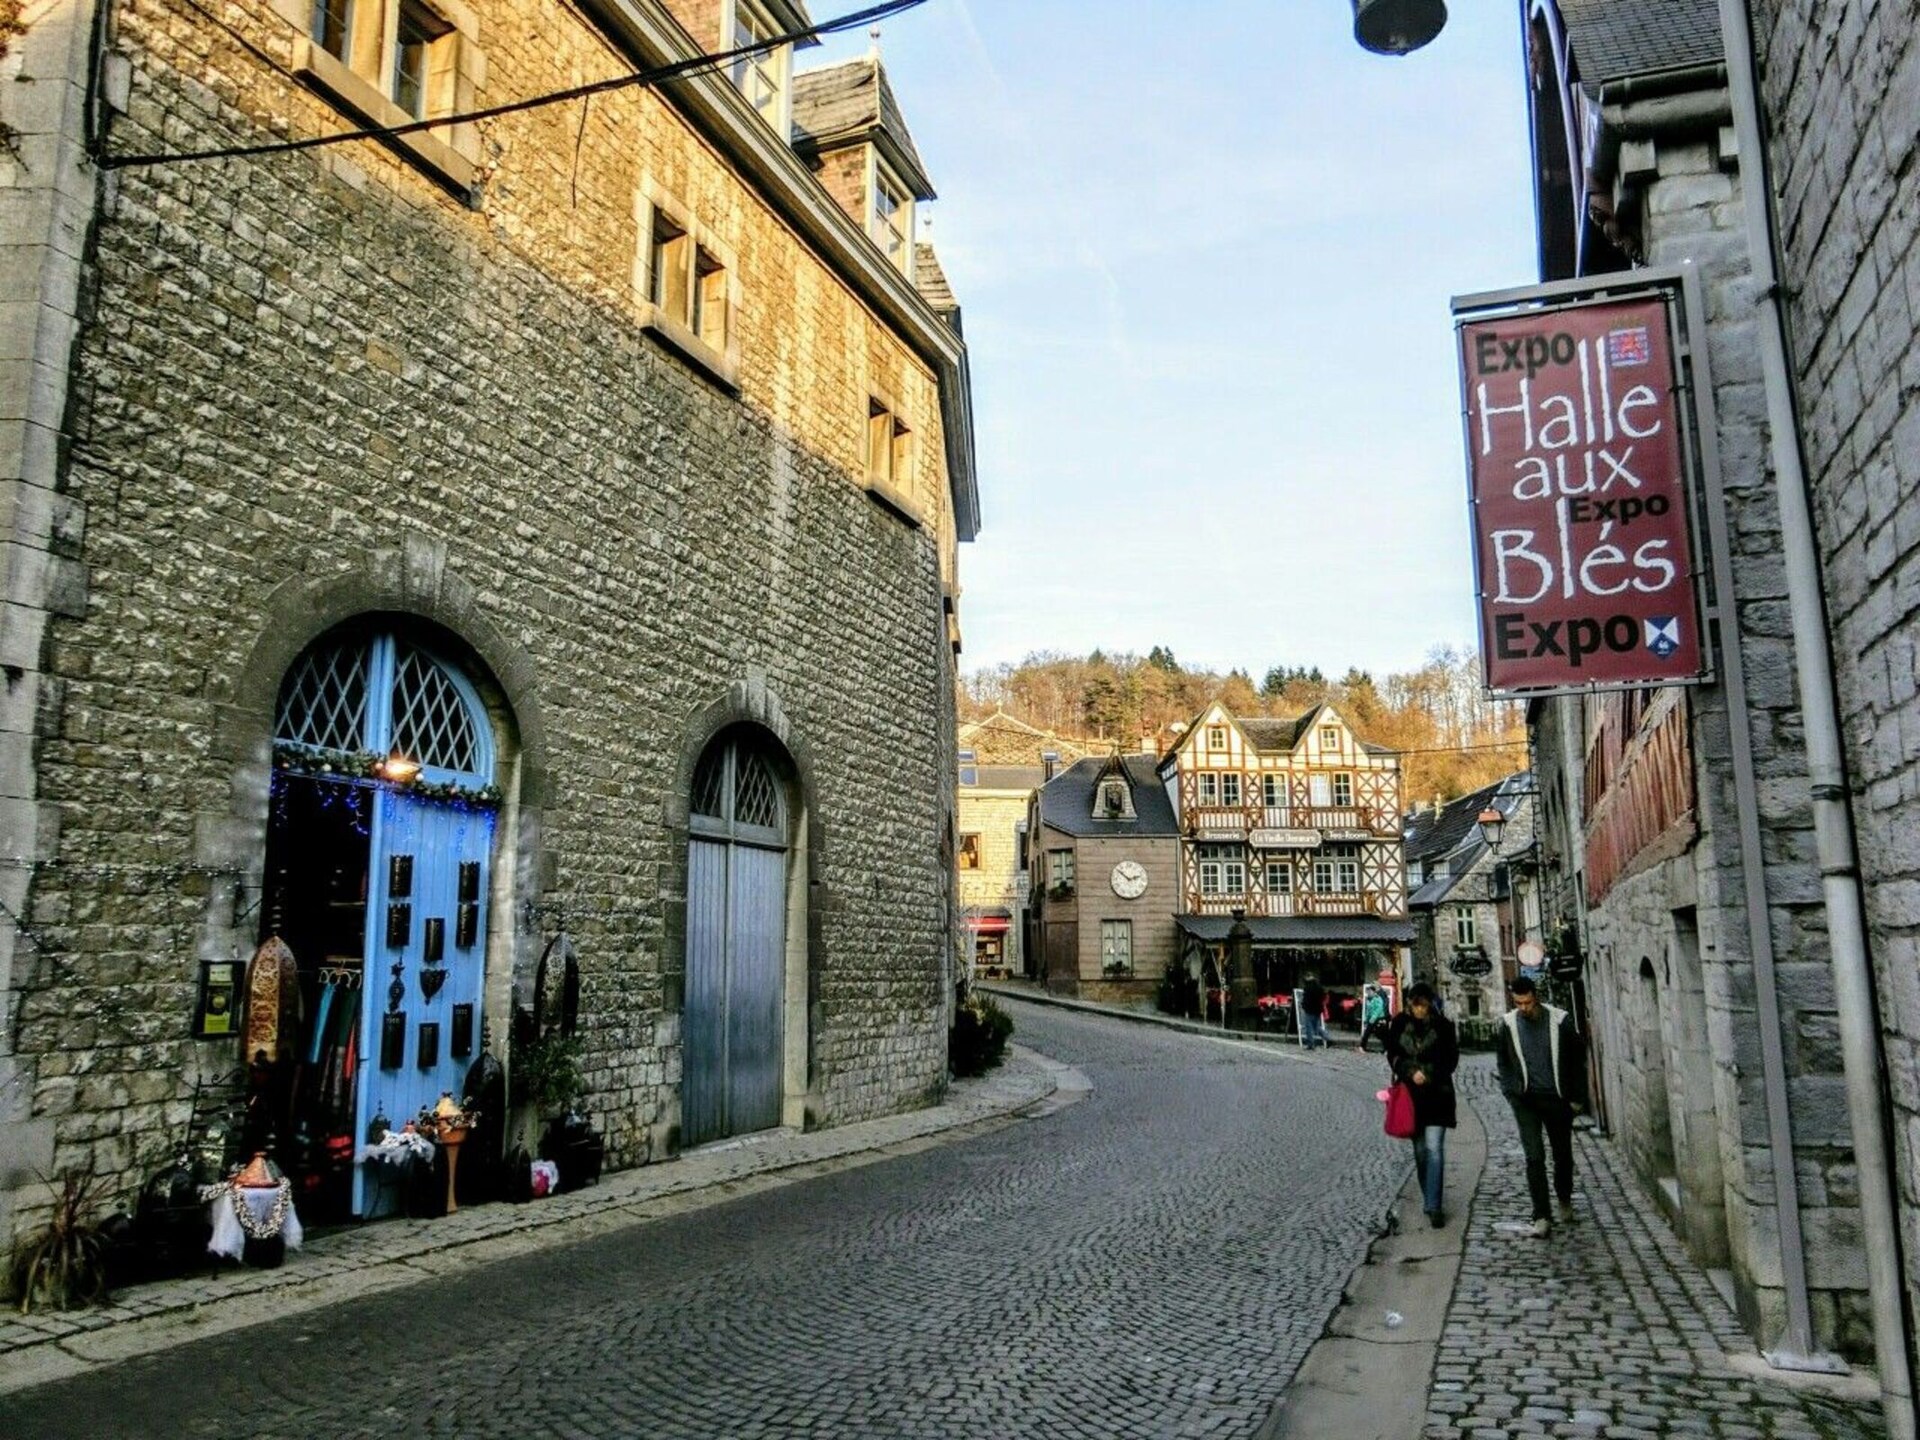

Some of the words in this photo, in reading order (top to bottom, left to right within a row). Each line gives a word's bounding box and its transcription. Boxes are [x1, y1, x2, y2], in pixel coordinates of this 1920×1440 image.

[1476, 332, 1575, 378] Expo
[1477, 336, 1661, 455] Halle
[1512, 446, 1641, 500] aux
[1569, 494, 1669, 524] Expo
[1490, 496, 1675, 603] Blés
[1496, 614, 1639, 666] Expo
